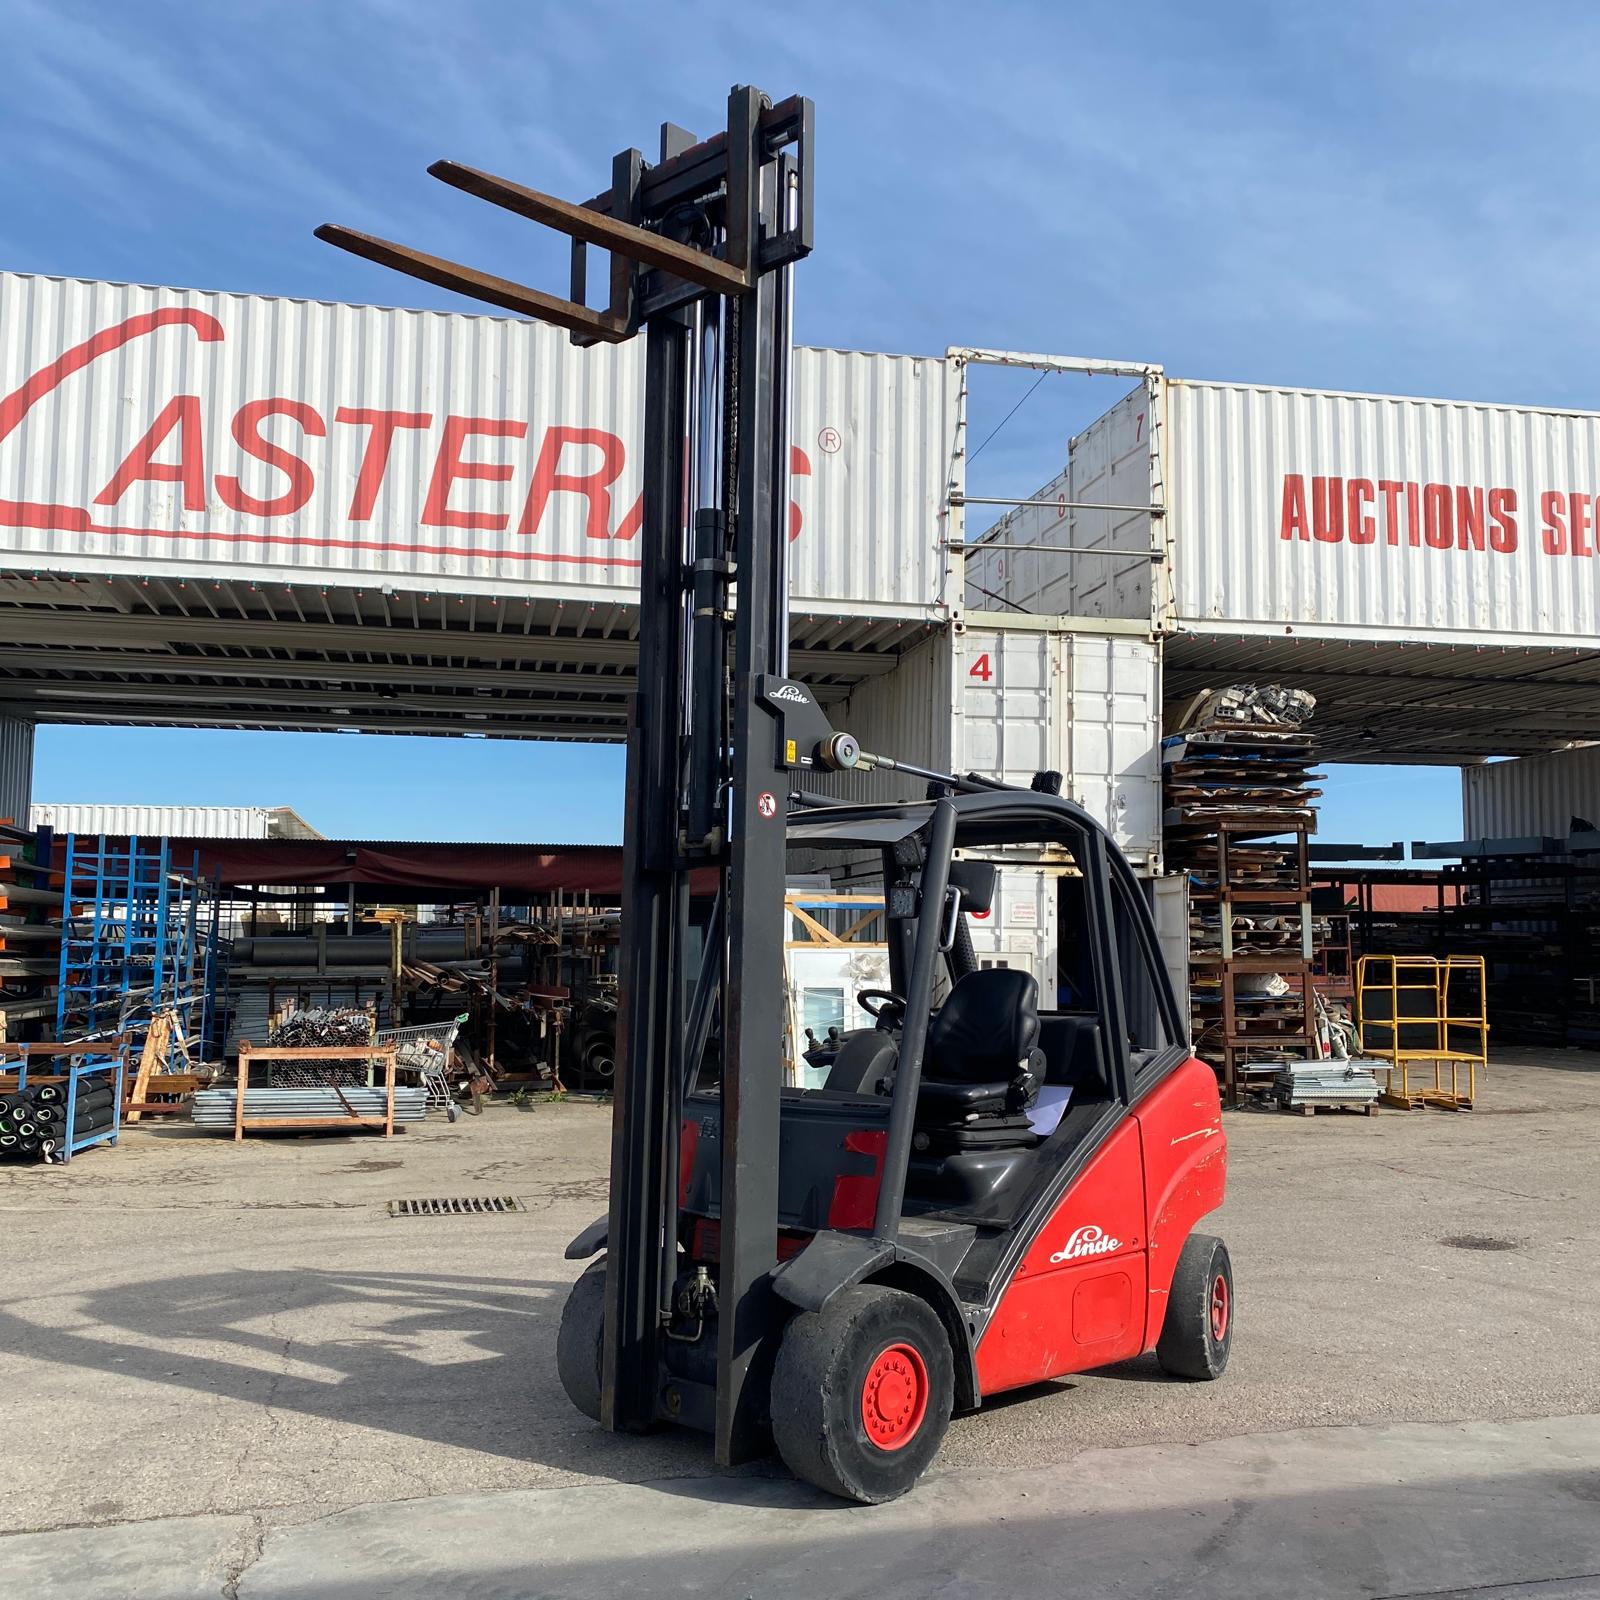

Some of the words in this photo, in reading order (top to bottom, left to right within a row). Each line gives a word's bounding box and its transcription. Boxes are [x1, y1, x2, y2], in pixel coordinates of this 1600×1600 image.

[0, 307, 812, 545] CASTER
[1136, 413, 1145, 442] 7
[1058, 493, 1065, 519] 8
[1280, 473, 1518, 554] AUCTIONS
[1541, 491, 1600, 558] SE
[970, 653, 993, 681] 4
[768, 685, 811, 704] Linde
[1050, 1225, 1123, 1263] Linde
